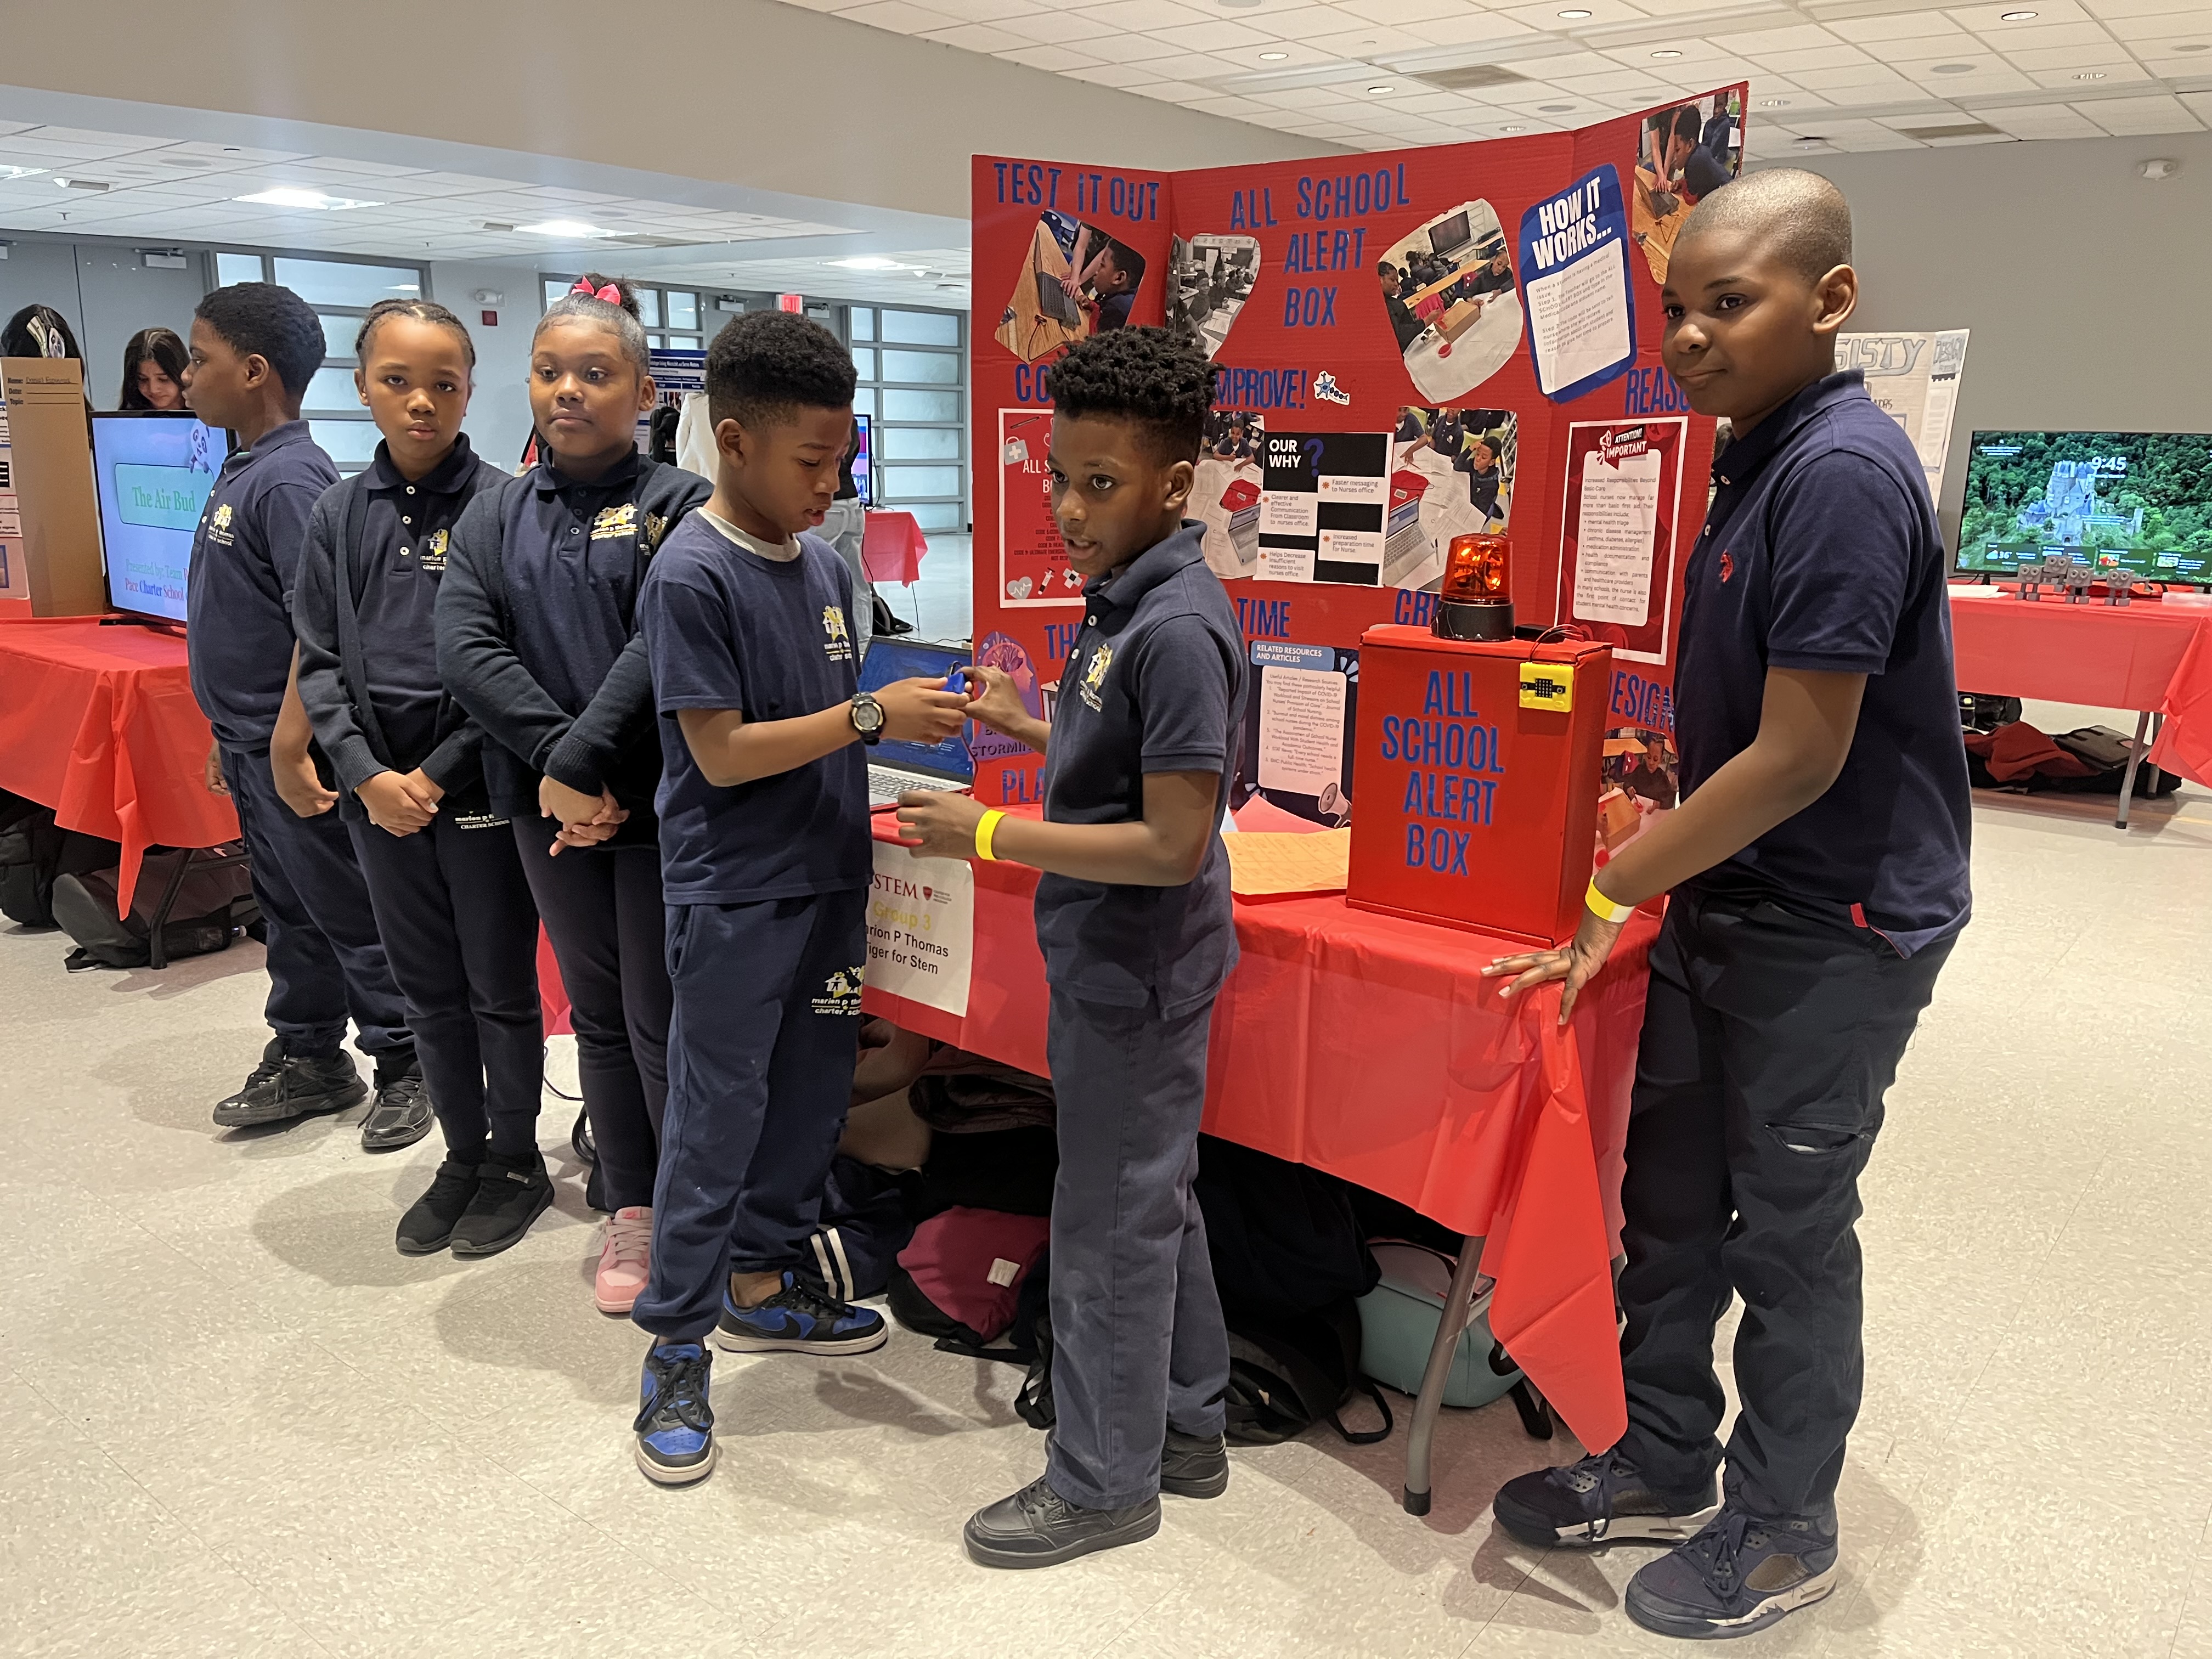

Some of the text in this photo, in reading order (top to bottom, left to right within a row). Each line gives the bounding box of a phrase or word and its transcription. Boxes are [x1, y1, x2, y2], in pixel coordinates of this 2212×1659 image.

[994, 163, 1159, 222] TEST IT OUT
[1230, 163, 1410, 230] ALL SCHOOL
[1539, 176, 1600, 236] HOW IT
[1283, 227, 1367, 274] ALERT
[1532, 213, 1611, 269] WORKS...
[1577, 264, 1589, 274] having
[1283, 286, 1338, 328] BOX
[1214, 368, 1307, 409] MPROVE!
[1269, 439, 1297, 452] OUR
[1606, 441, 1647, 458] IMPORTANT
[1615, 427, 1642, 443] ATTENTION!
[1023, 460, 1041, 473] ALL
[1269, 455, 1301, 468] WHY
[2091, 456, 2126, 471] 9:45
[132, 486, 196, 512] The Air Bud
[126, 559, 154, 575] Presented
[166, 565, 183, 580] Team
[125, 578, 184, 601] Pace Charter School
[1237, 598, 1290, 637] TIME
[1045, 623, 1081, 659] TH
[1257, 645, 1322, 657] RELATED RESOURCES
[1272, 654, 1300, 663] ARTICLES
[1424, 671, 1478, 718] ALL
[1609, 670, 1674, 732] ESIGN
[1381, 716, 1505, 774] SCHOOL
[1403, 771, 1499, 826] ALERT
[1406, 822, 1471, 876] BOX
[874, 873, 918, 900] STEM
[873, 900, 931, 930] Group 3
[866, 924, 949, 957] rion P Thomas
[867, 941, 938, 974] iger for Stem
